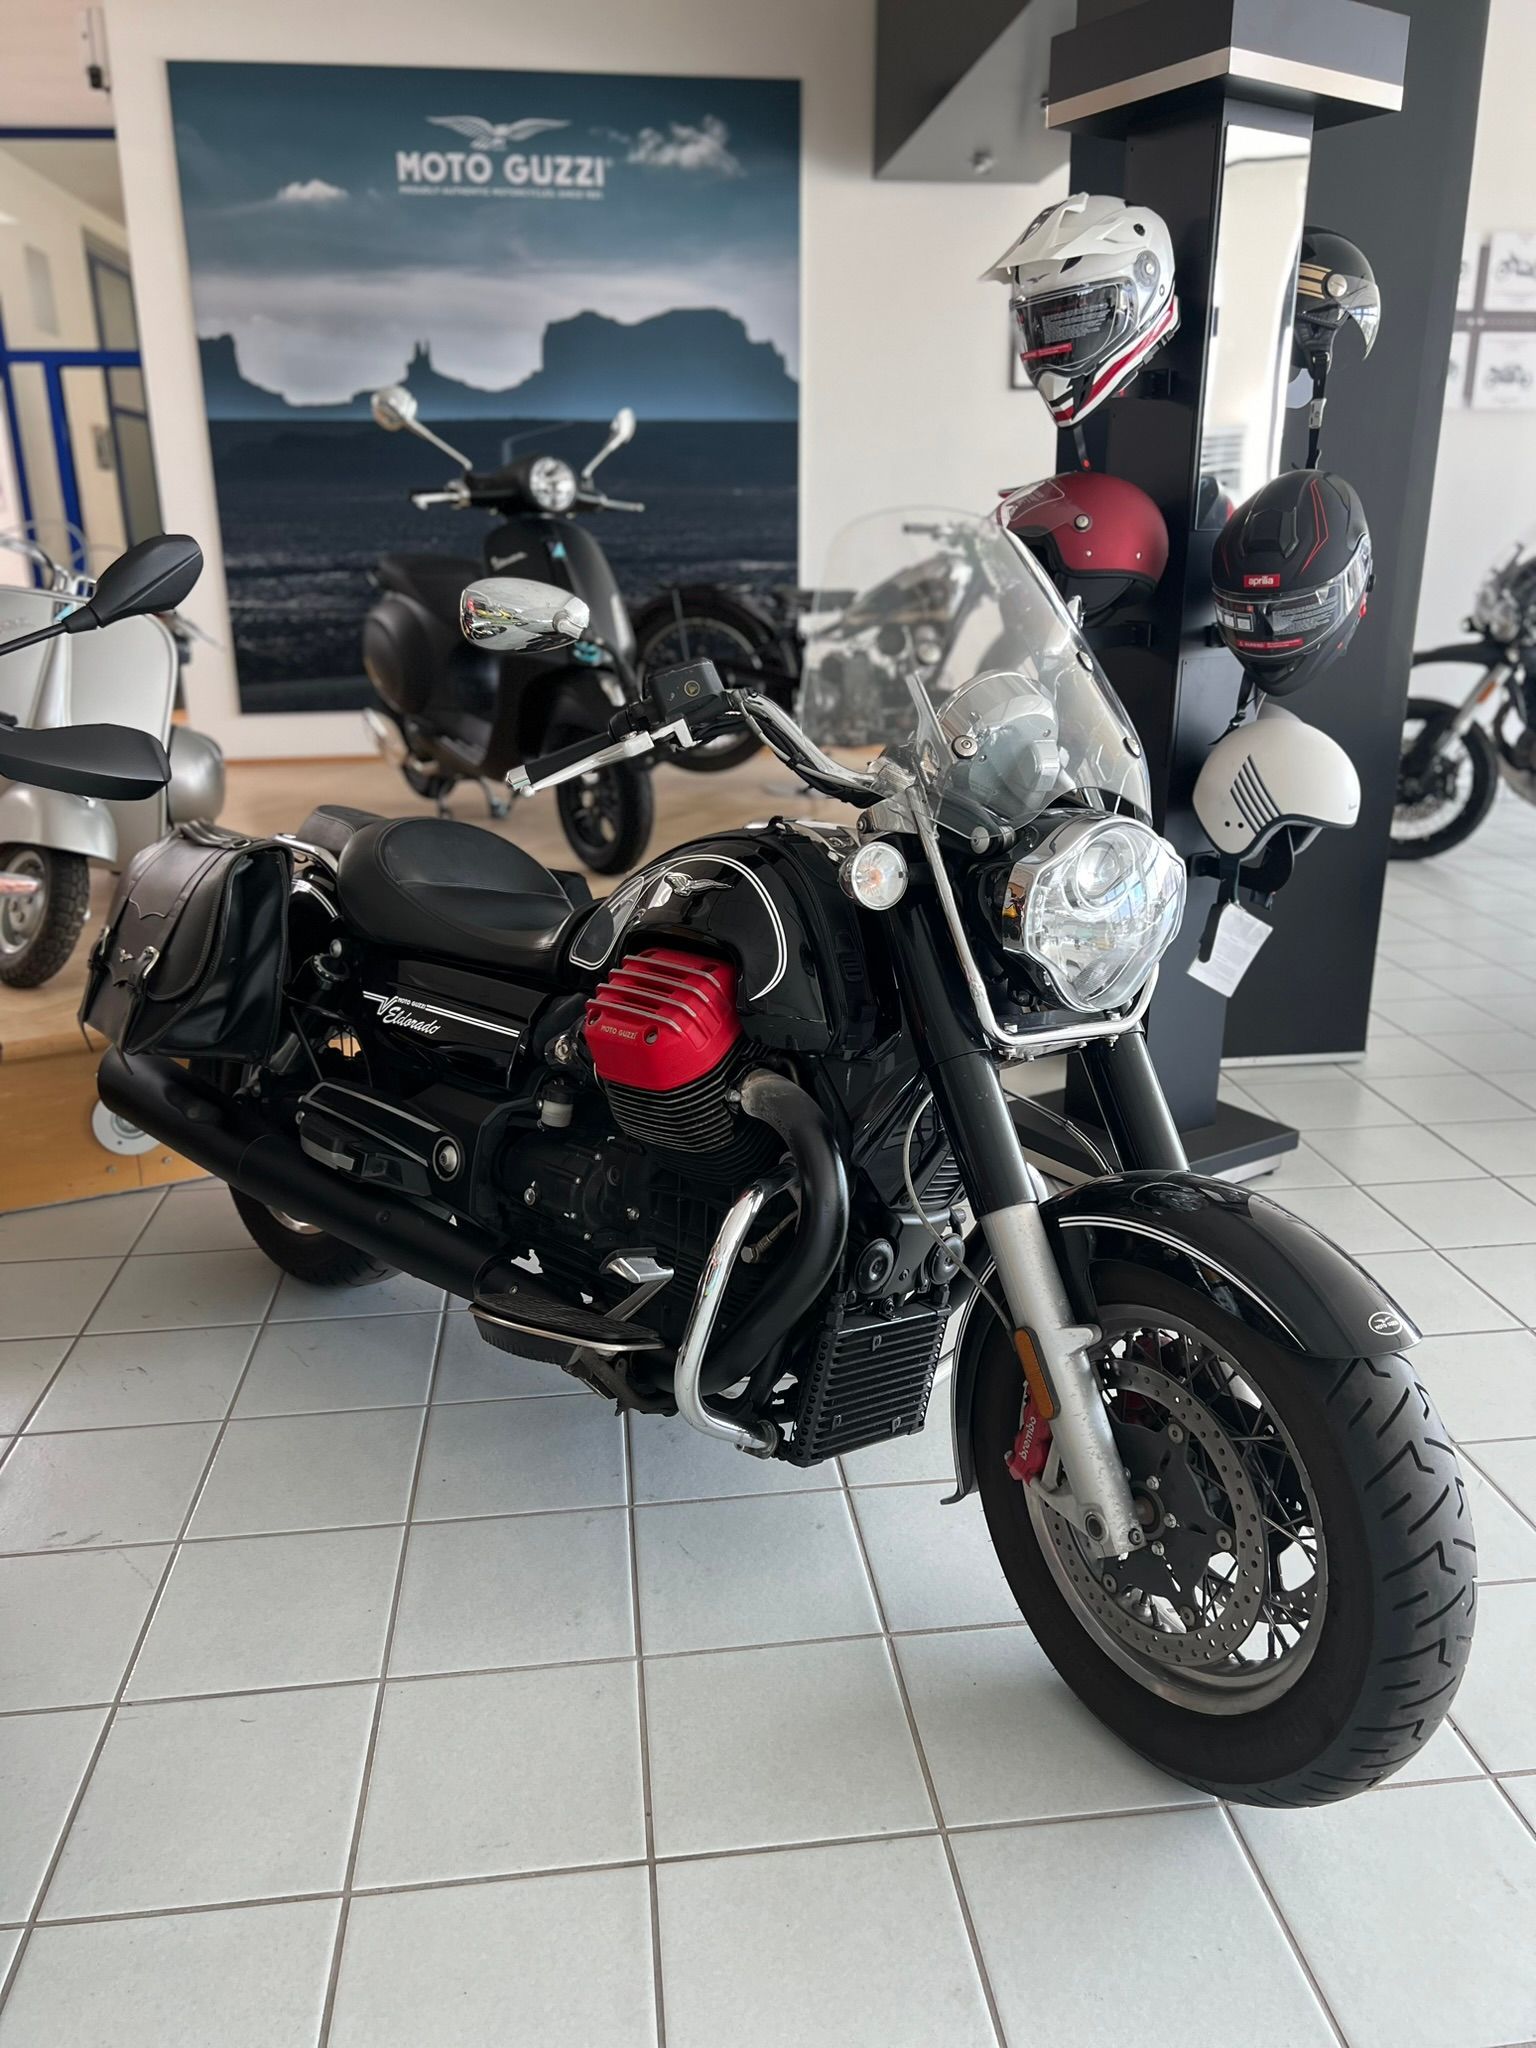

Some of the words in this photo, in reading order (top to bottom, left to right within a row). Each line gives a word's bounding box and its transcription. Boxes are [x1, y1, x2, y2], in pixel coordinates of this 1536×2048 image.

[396, 152, 493, 183] MOTO
[503, 154, 605, 187] GUZZI
[1248, 575, 1274, 587] aprilia
[383, 1006, 441, 1034] Eldorado
[601, 1025, 618, 1035] MOTO
[618, 1029, 638, 1040] GUZZI
[1018, 1416, 1037, 1461] brembo
